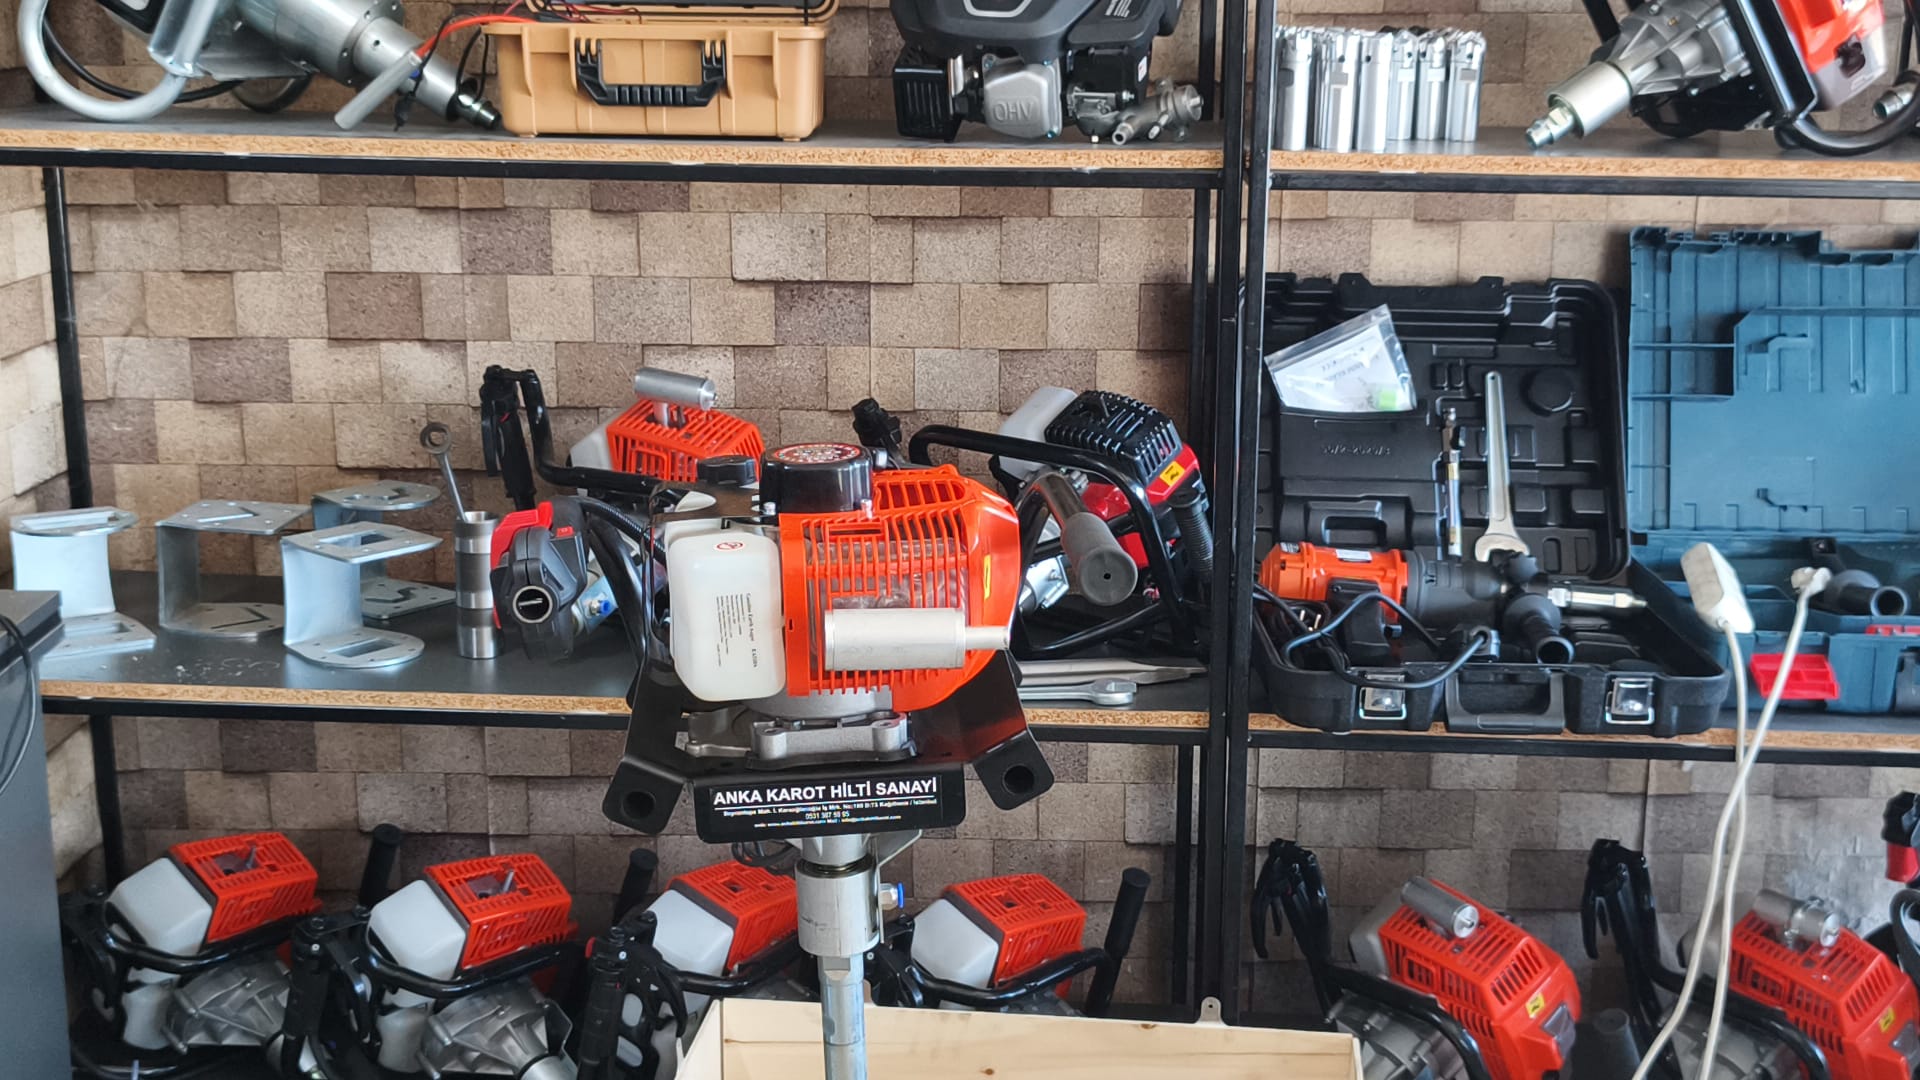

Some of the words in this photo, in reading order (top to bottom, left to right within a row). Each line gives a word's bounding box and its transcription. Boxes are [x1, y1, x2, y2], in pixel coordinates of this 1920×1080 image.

[993, 101, 1034, 122] OHV
[713, 790, 763, 805] ANKA
[766, 786, 826, 802] KAROT
[830, 780, 871, 799] HİLTİ
[875, 777, 937, 796] SANAYİ
